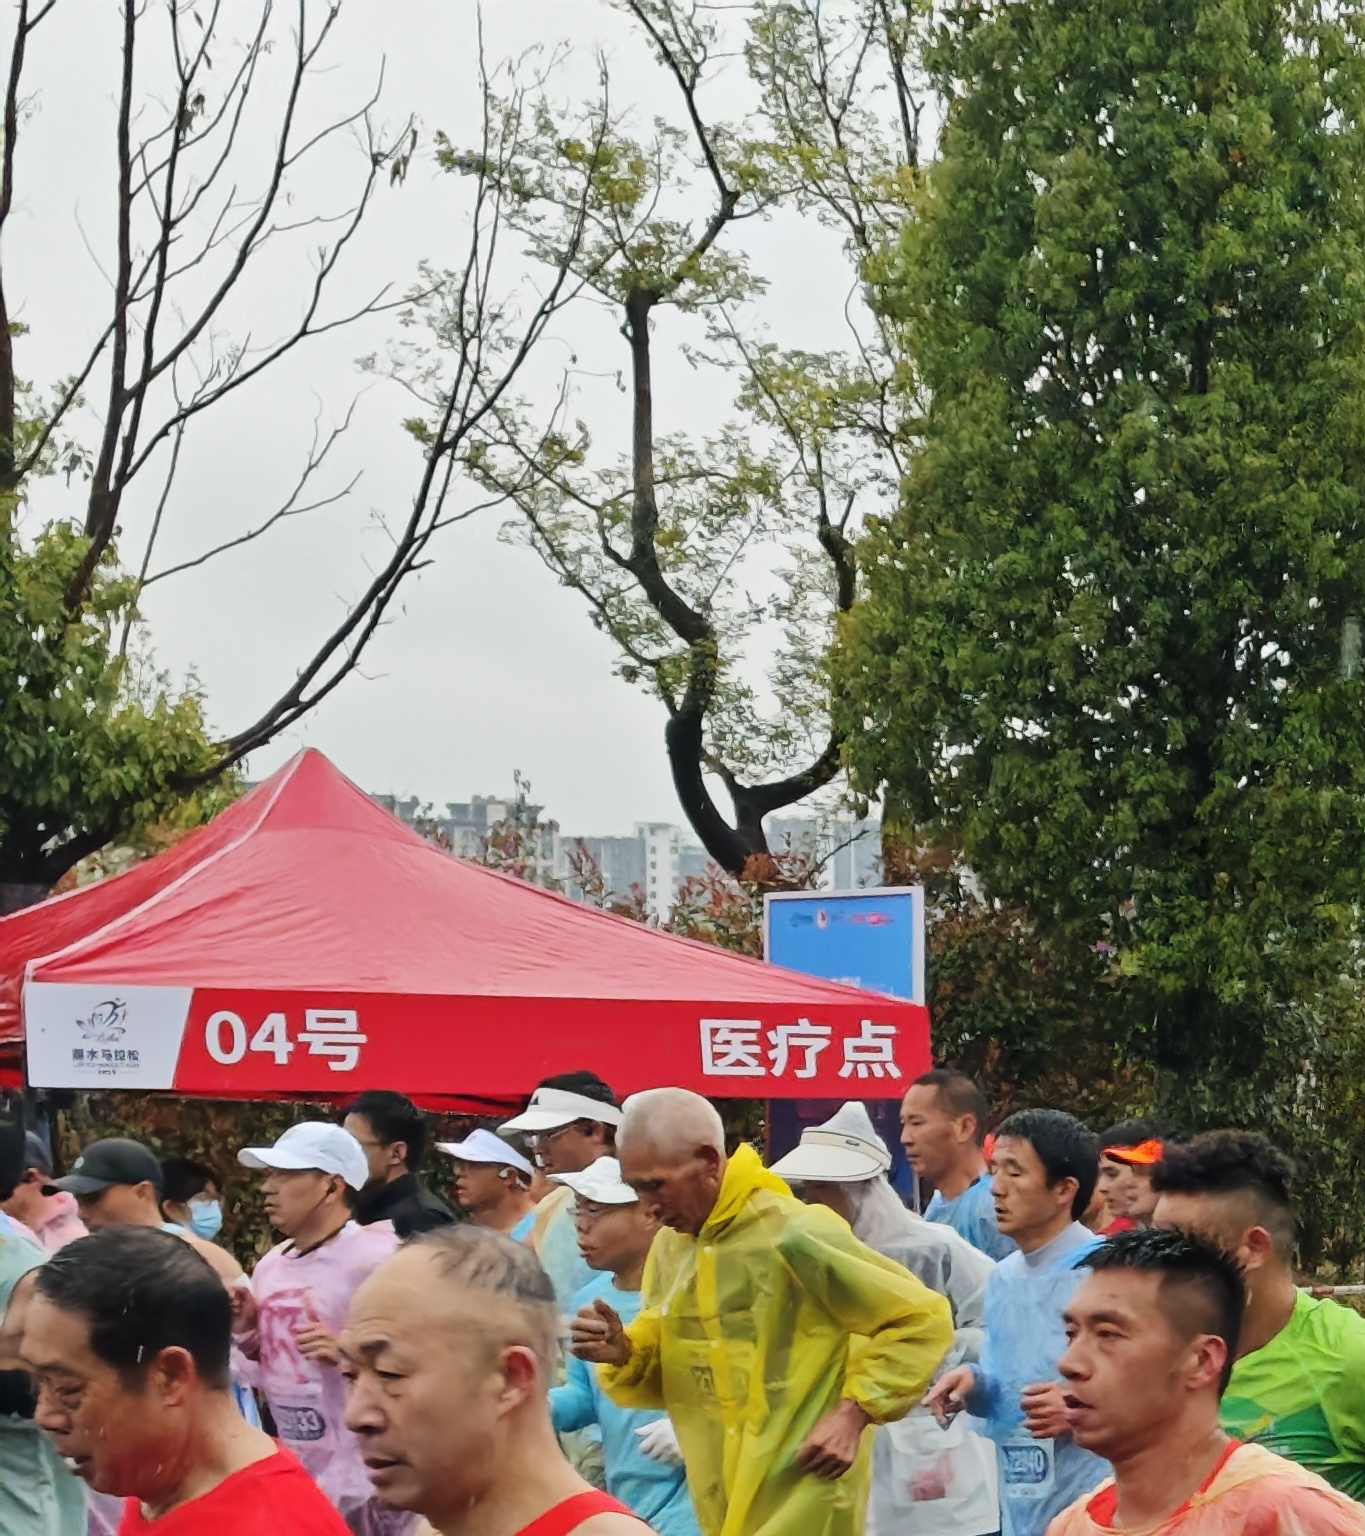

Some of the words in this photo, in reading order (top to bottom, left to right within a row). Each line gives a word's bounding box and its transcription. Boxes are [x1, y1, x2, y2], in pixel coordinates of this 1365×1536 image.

[205, 1009, 368, 1072] 04号
[698, 1018, 901, 1080] 医疗点
